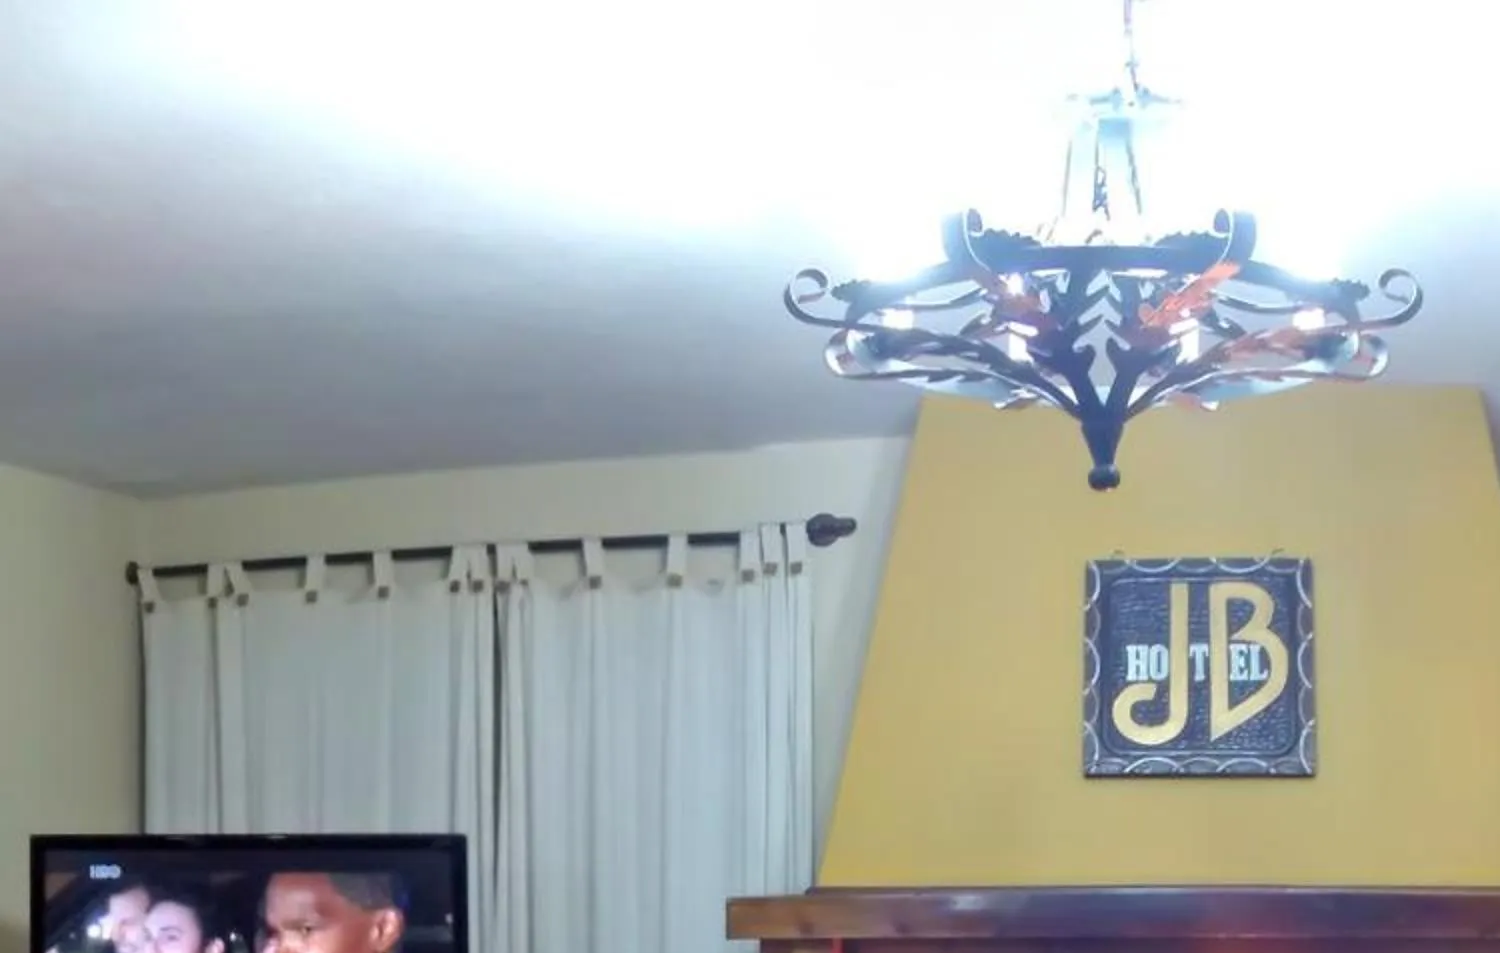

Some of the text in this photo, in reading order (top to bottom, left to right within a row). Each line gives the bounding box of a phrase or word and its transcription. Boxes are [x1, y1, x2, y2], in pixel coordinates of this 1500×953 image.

[1112, 581, 1289, 745] JB
[1125, 643, 1269, 682] HOTEL
[89, 864, 121, 880] HBO
